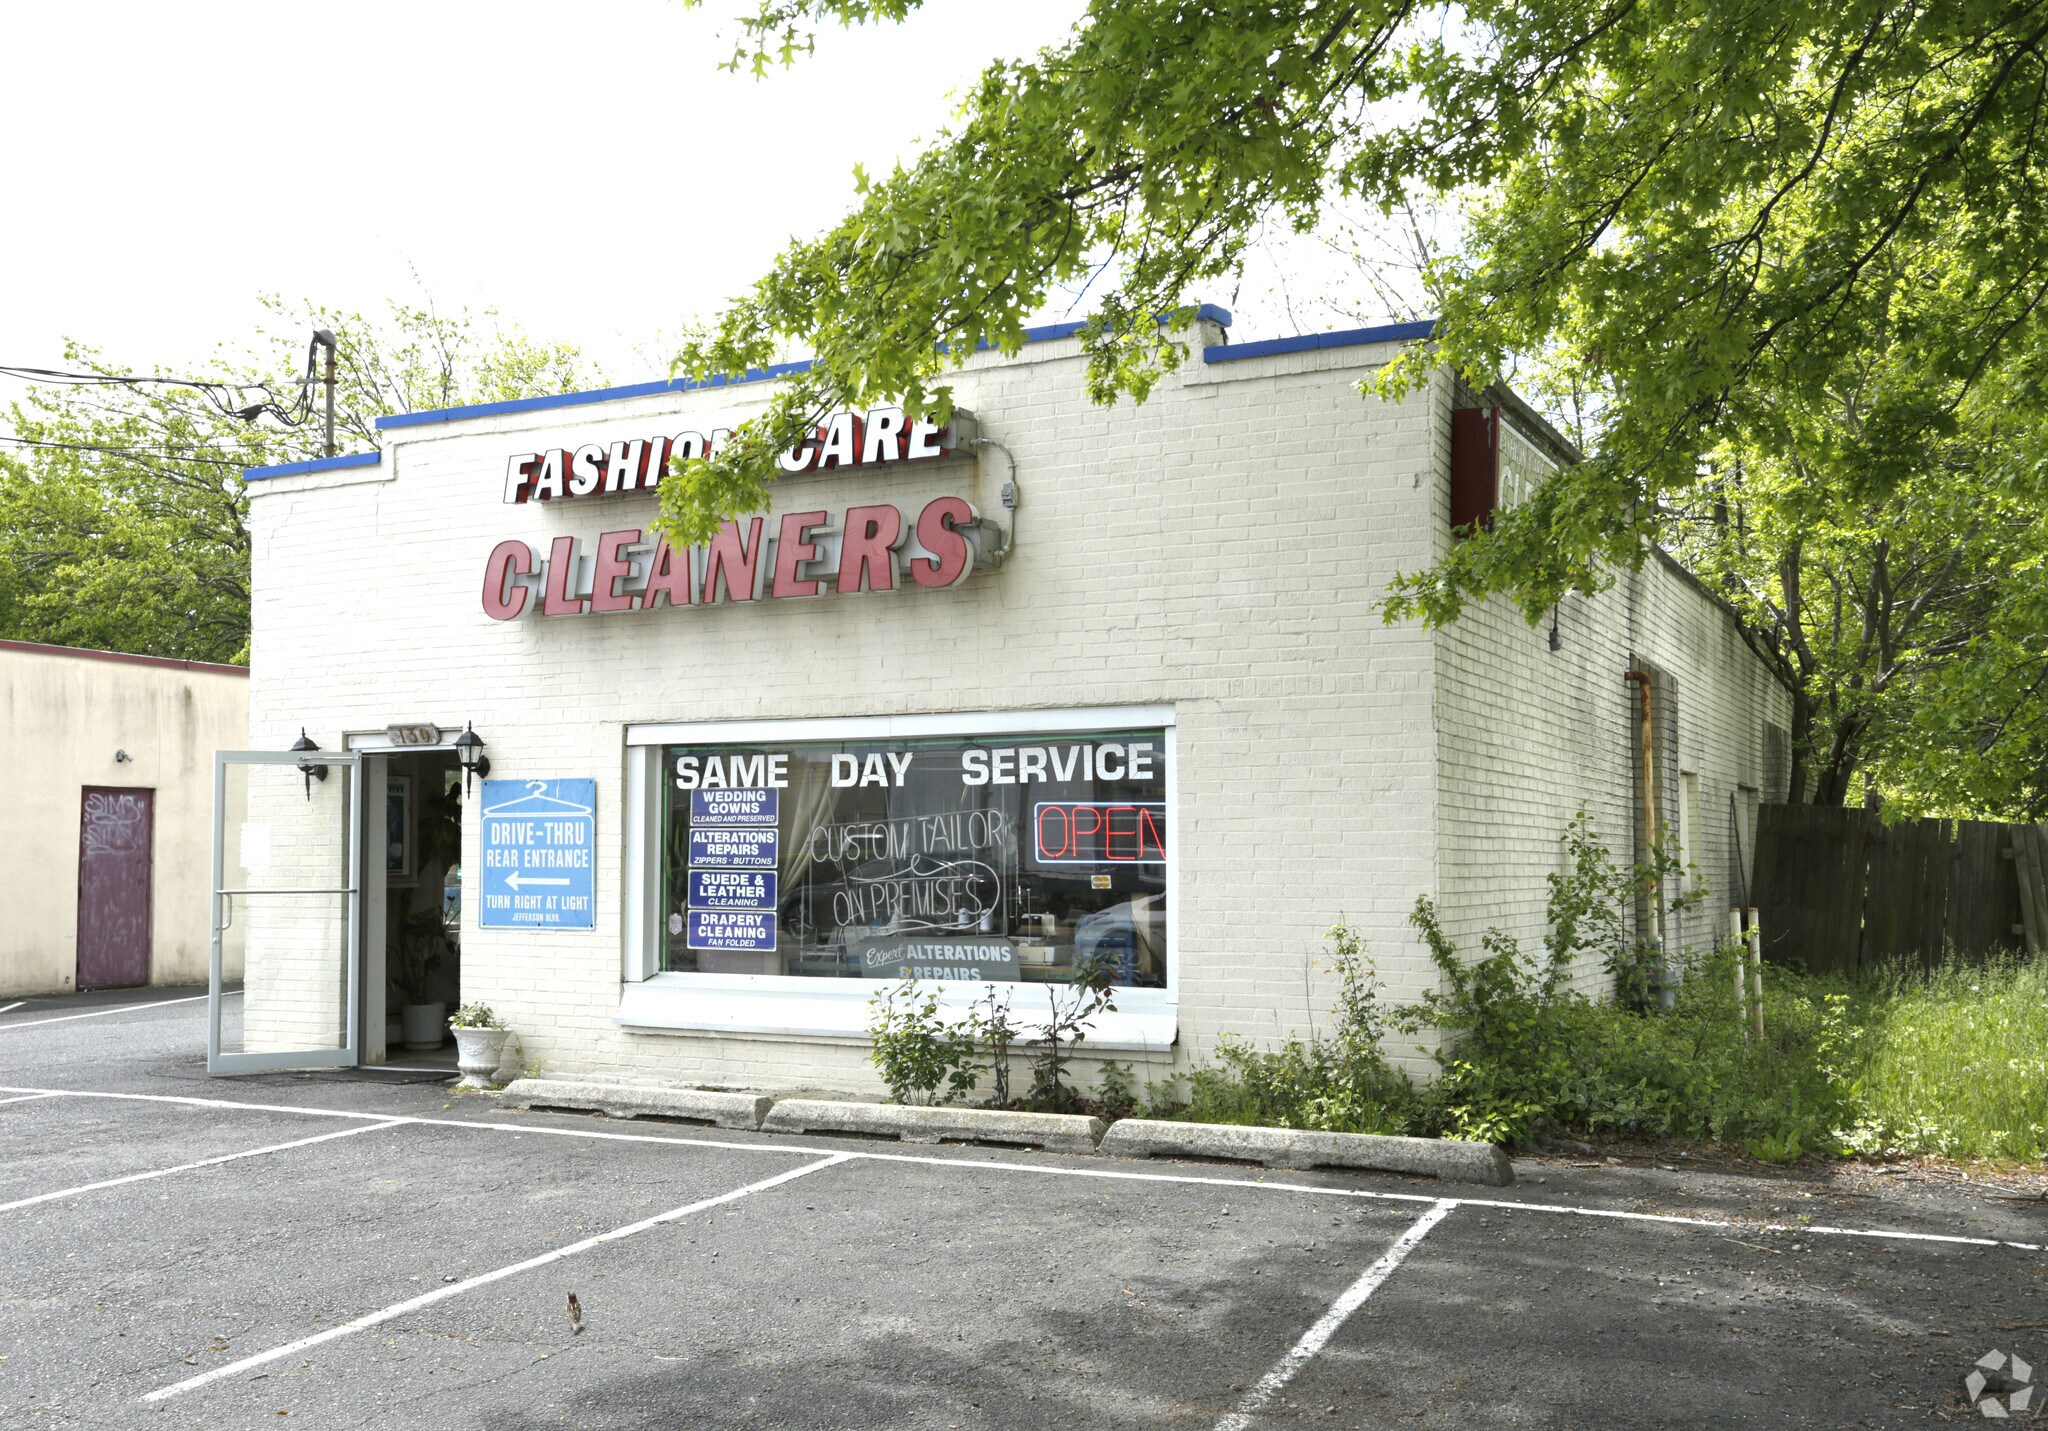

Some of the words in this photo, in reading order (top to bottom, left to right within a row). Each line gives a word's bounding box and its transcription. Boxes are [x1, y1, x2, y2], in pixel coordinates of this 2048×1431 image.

[482, 496, 974, 621] CLEANERS
[398, 727, 431, 744] 130
[676, 753, 789, 790] SAME
[831, 752, 914, 788] DAY
[962, 742, 1154, 785] SERVICE
[703, 790, 766, 802] WEDDING
[708, 802, 760, 814] GOWNS
[693, 815, 723, 823] CLEANED
[737, 814, 775, 822] PRESERVED
[491, 822, 585, 846] DRIVE-THRU
[693, 832, 775, 843] ALTERATIONS
[811, 823, 910, 863] CUSTOM
[917, 810, 1002, 854] TAILOR
[707, 844, 759, 855] REPAIRS
[486, 849, 519, 868] REAR
[524, 849, 589, 868] ENTRANCE
[694, 856, 728, 864] ZIPPERS
[733, 857, 772, 865] BUTTONS
[701, 873, 750, 885] SUEDE
[754, 874, 765, 886] &
[699, 885, 765, 897] LEATHER
[486, 895, 510, 909] TURN
[514, 895, 542, 910] RIGHT
[546, 895, 557, 910] AT
[561, 896, 588, 910] LIGHT
[708, 898, 758, 906] CLEANING
[834, 887, 866, 927] ON
[871, 876, 985, 919] PREMISES
[512, 913, 544, 922] JEFFERSON
[701, 913, 763, 926] DRAPERY
[698, 926, 766, 938] CLEANING
[708, 938, 724, 946] FAN
[725, 939, 756, 947] FOLDED
[866, 944, 906, 966] Expert
[907, 945, 1012, 962] ALTERATIONS
[913, 966, 982, 981] REPAIRS
